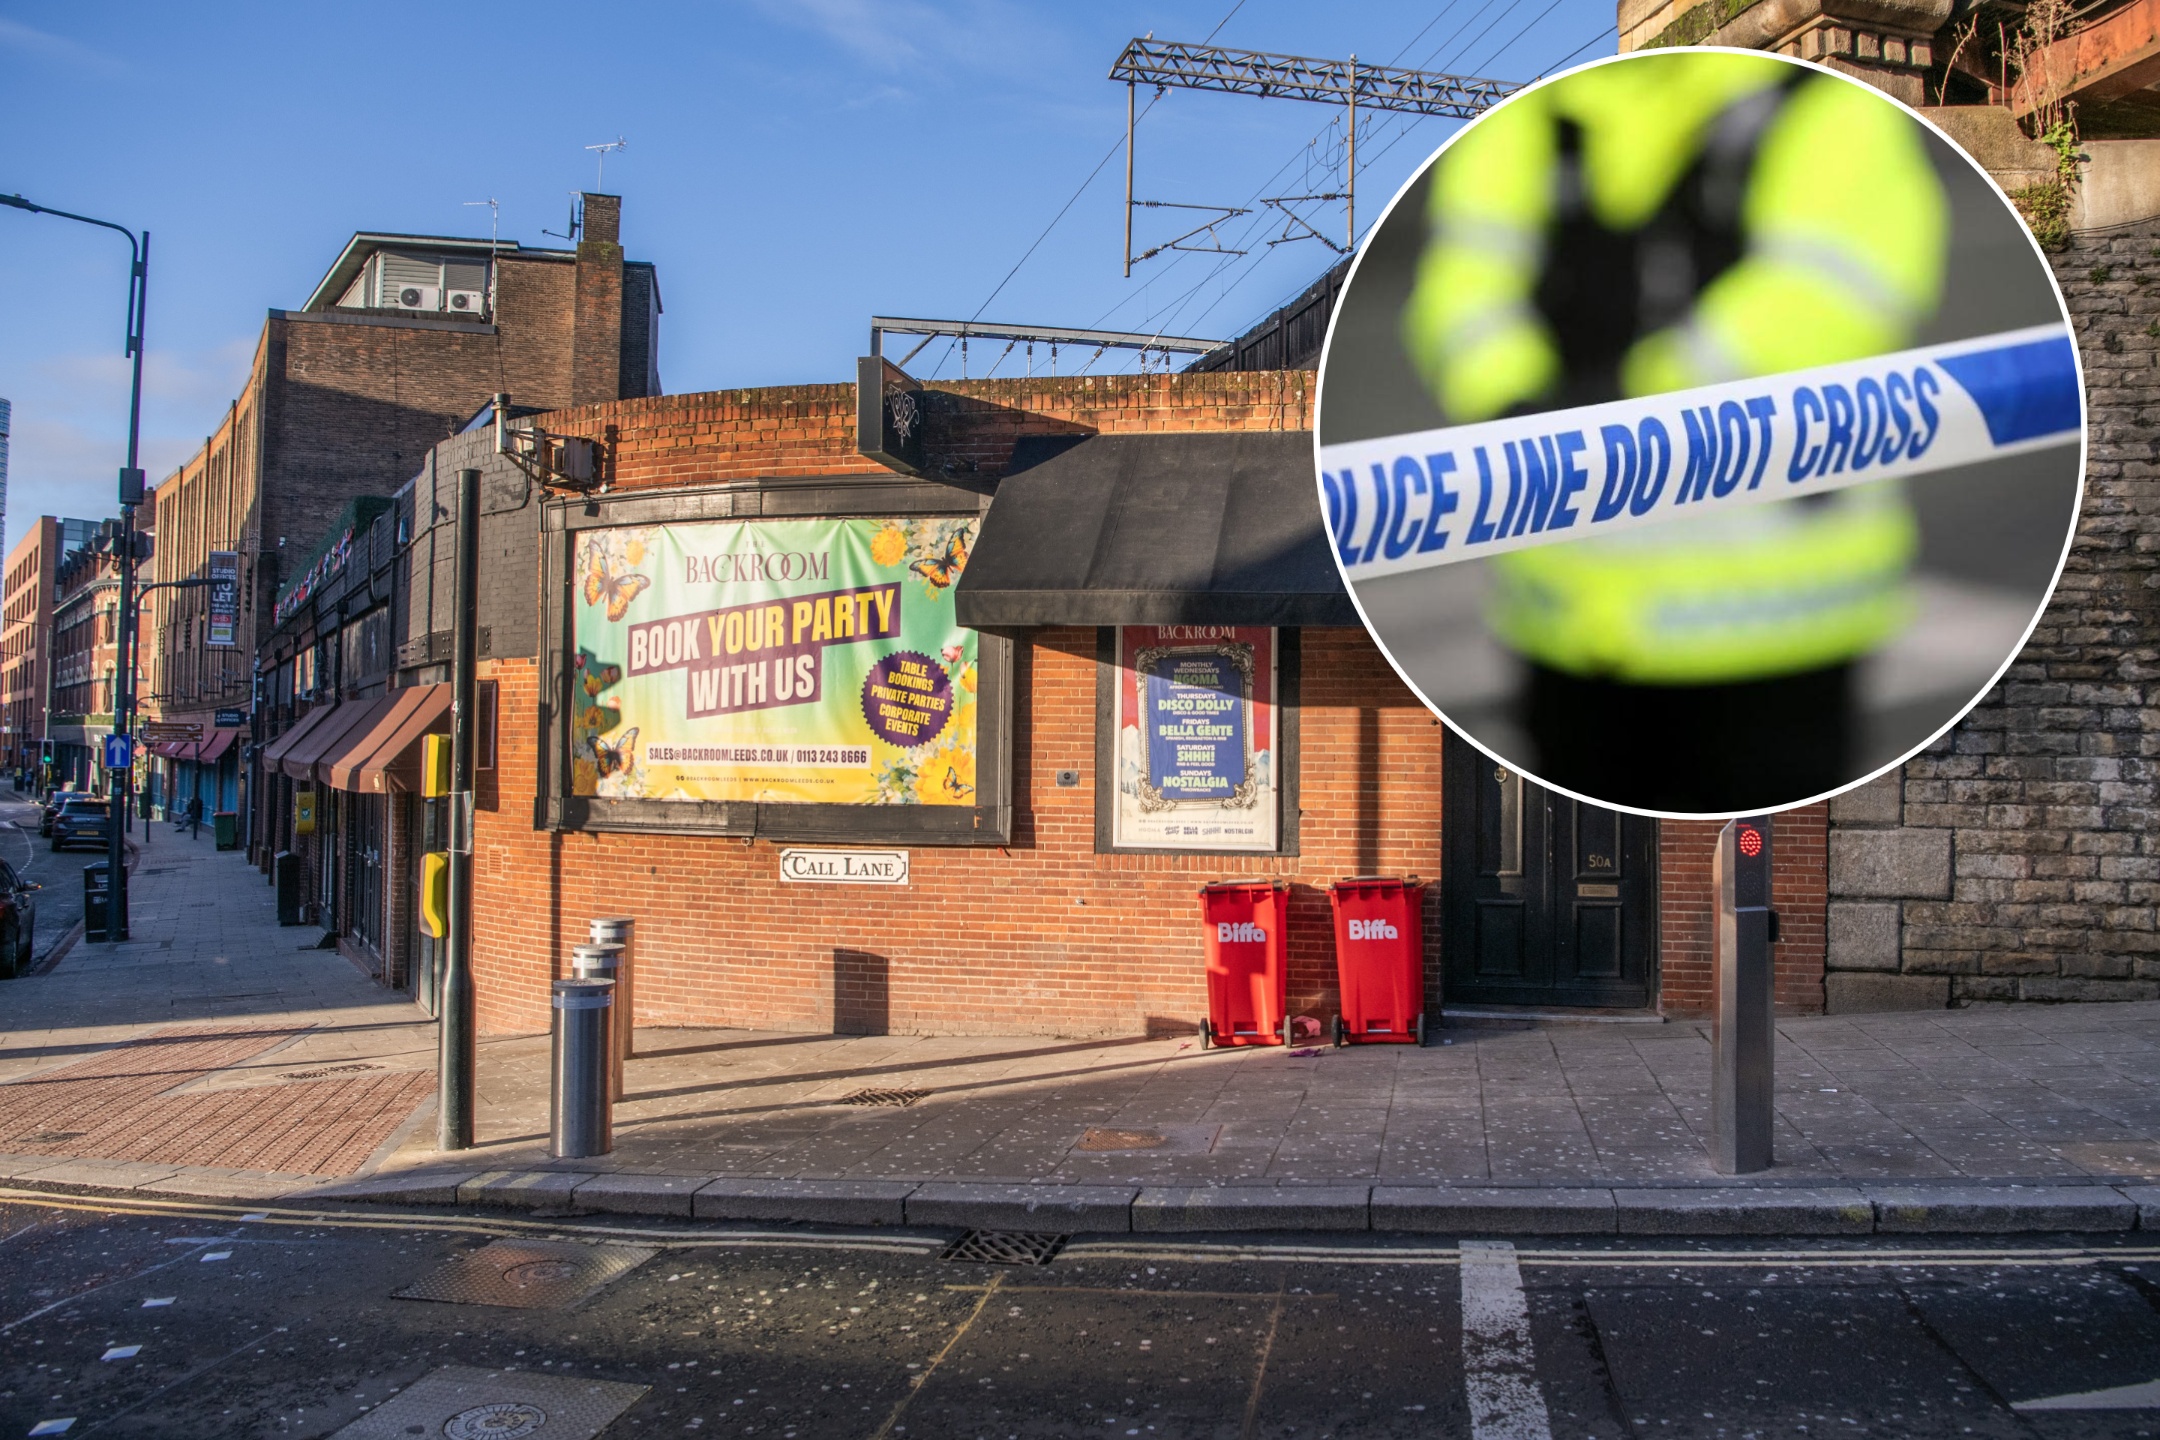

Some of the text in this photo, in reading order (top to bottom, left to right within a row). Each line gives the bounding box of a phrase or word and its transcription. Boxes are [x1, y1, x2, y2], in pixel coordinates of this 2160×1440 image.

[1464, 423, 1588, 546] LINE
[1591, 415, 1672, 523] DO
[1675, 395, 1778, 506] NOT
[1787, 366, 1940, 484] CROSS
[685, 551, 830, 584] BACKROOM
[212, 592, 233, 602] LET
[631, 589, 896, 671] BOOK YOUR PARTY
[1158, 625, 1235, 640] BACKROOM
[900, 660, 928, 677] TABLE
[691, 654, 815, 713] WITH US
[888, 671, 934, 692] BOOKINGS
[1173, 674, 1219, 685] NGOMA
[871, 685, 946, 711] PRIVATE PARTIES
[1158, 699, 1234, 711] DISCO DOLLY
[879, 703, 931, 725] CORPORATE
[885, 718, 919, 736] EVENTS
[1159, 725, 1233, 736] BELLA GENTE
[649, 747, 788, 762] SALES@BACKROOMLEEDS.CO.UK
[797, 750, 817, 763] 0113
[820, 750, 838, 763] 243
[841, 750, 867, 764] 8666
[1177, 751, 1215, 762] SHHH!
[1163, 776, 1229, 788] NOSTALGIA
[793, 856, 894, 877] CALL LANE
[1589, 854, 1612, 868] 50A
[1218, 922, 1266, 943] Biffa
[1348, 919, 1398, 940] Biffa
